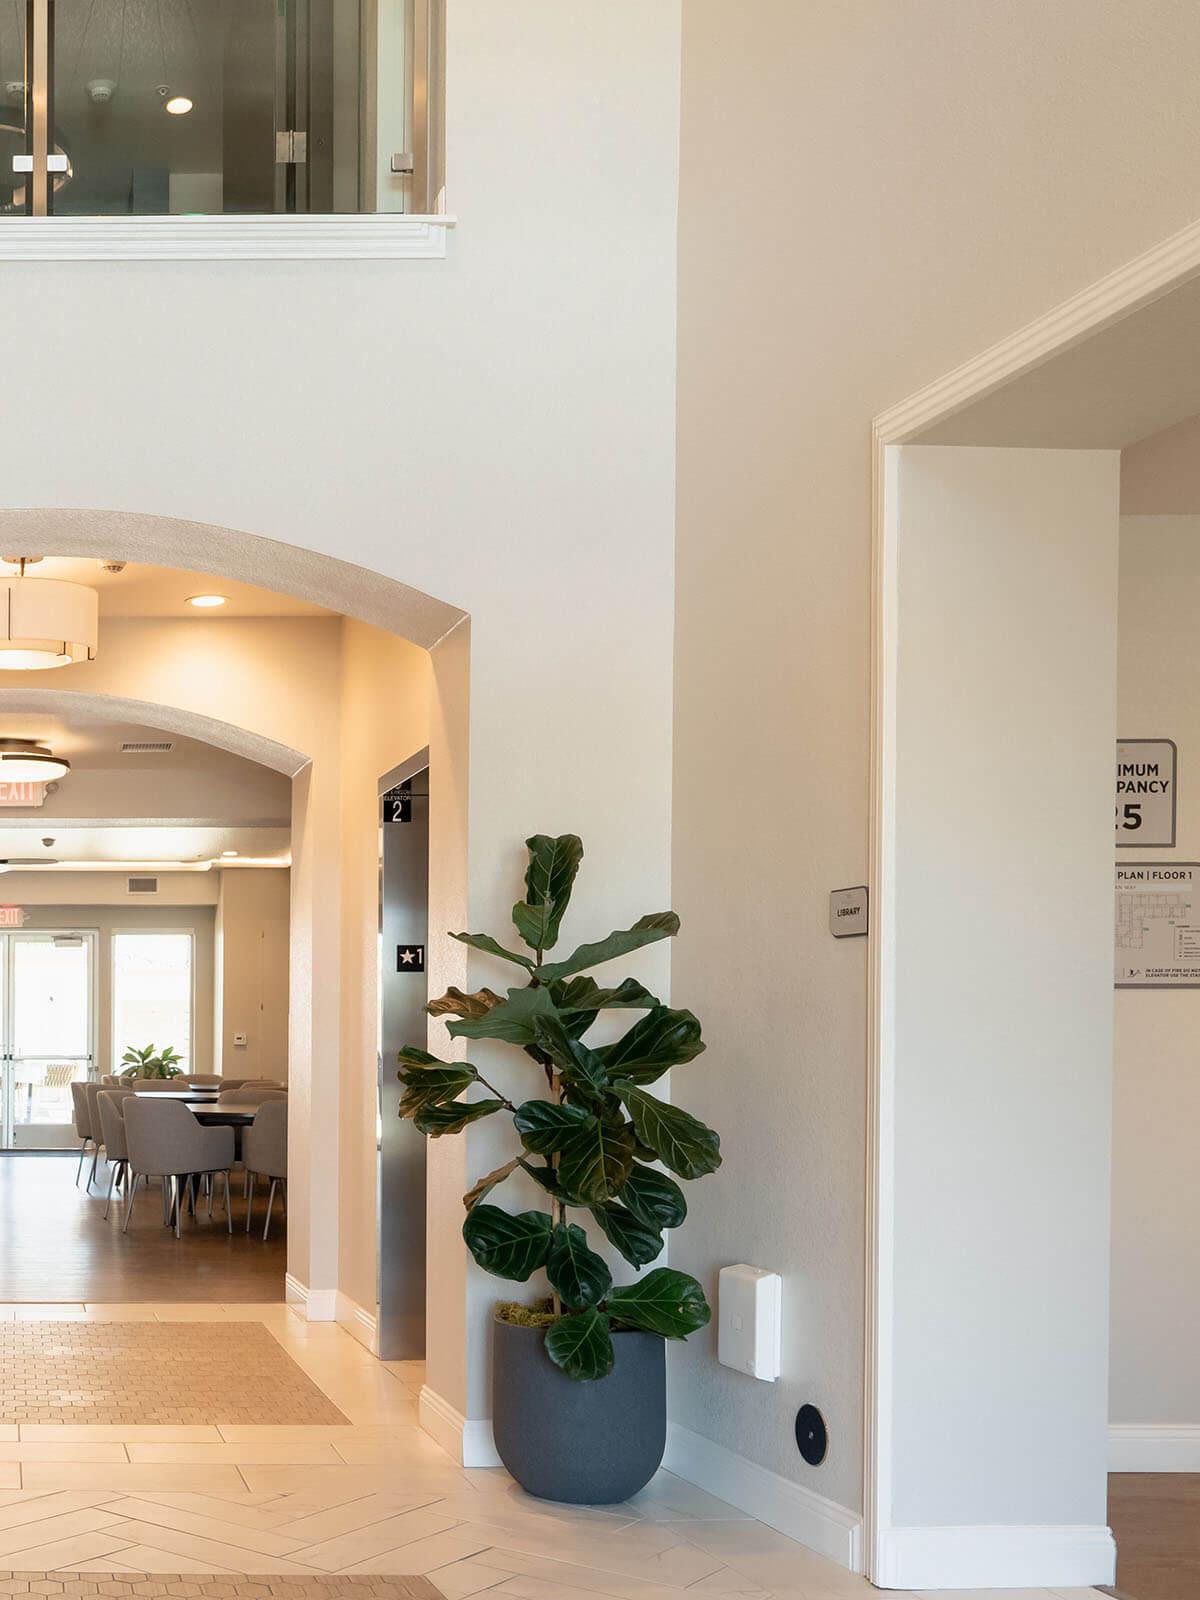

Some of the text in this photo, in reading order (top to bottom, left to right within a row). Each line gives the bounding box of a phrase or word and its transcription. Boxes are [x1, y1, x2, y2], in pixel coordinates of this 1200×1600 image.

[1117, 763, 1158, 777] IMUM
[1116, 780, 1169, 793] PANCY
[392, 800, 402, 822] 2
[1117, 871, 1144, 880] PLAN
[1152, 871, 1186, 880] FLOOR
[1187, 871, 1192, 880] 1
[837, 906, 860, 917] LIBRARY
[416, 948, 422, 964] 1
